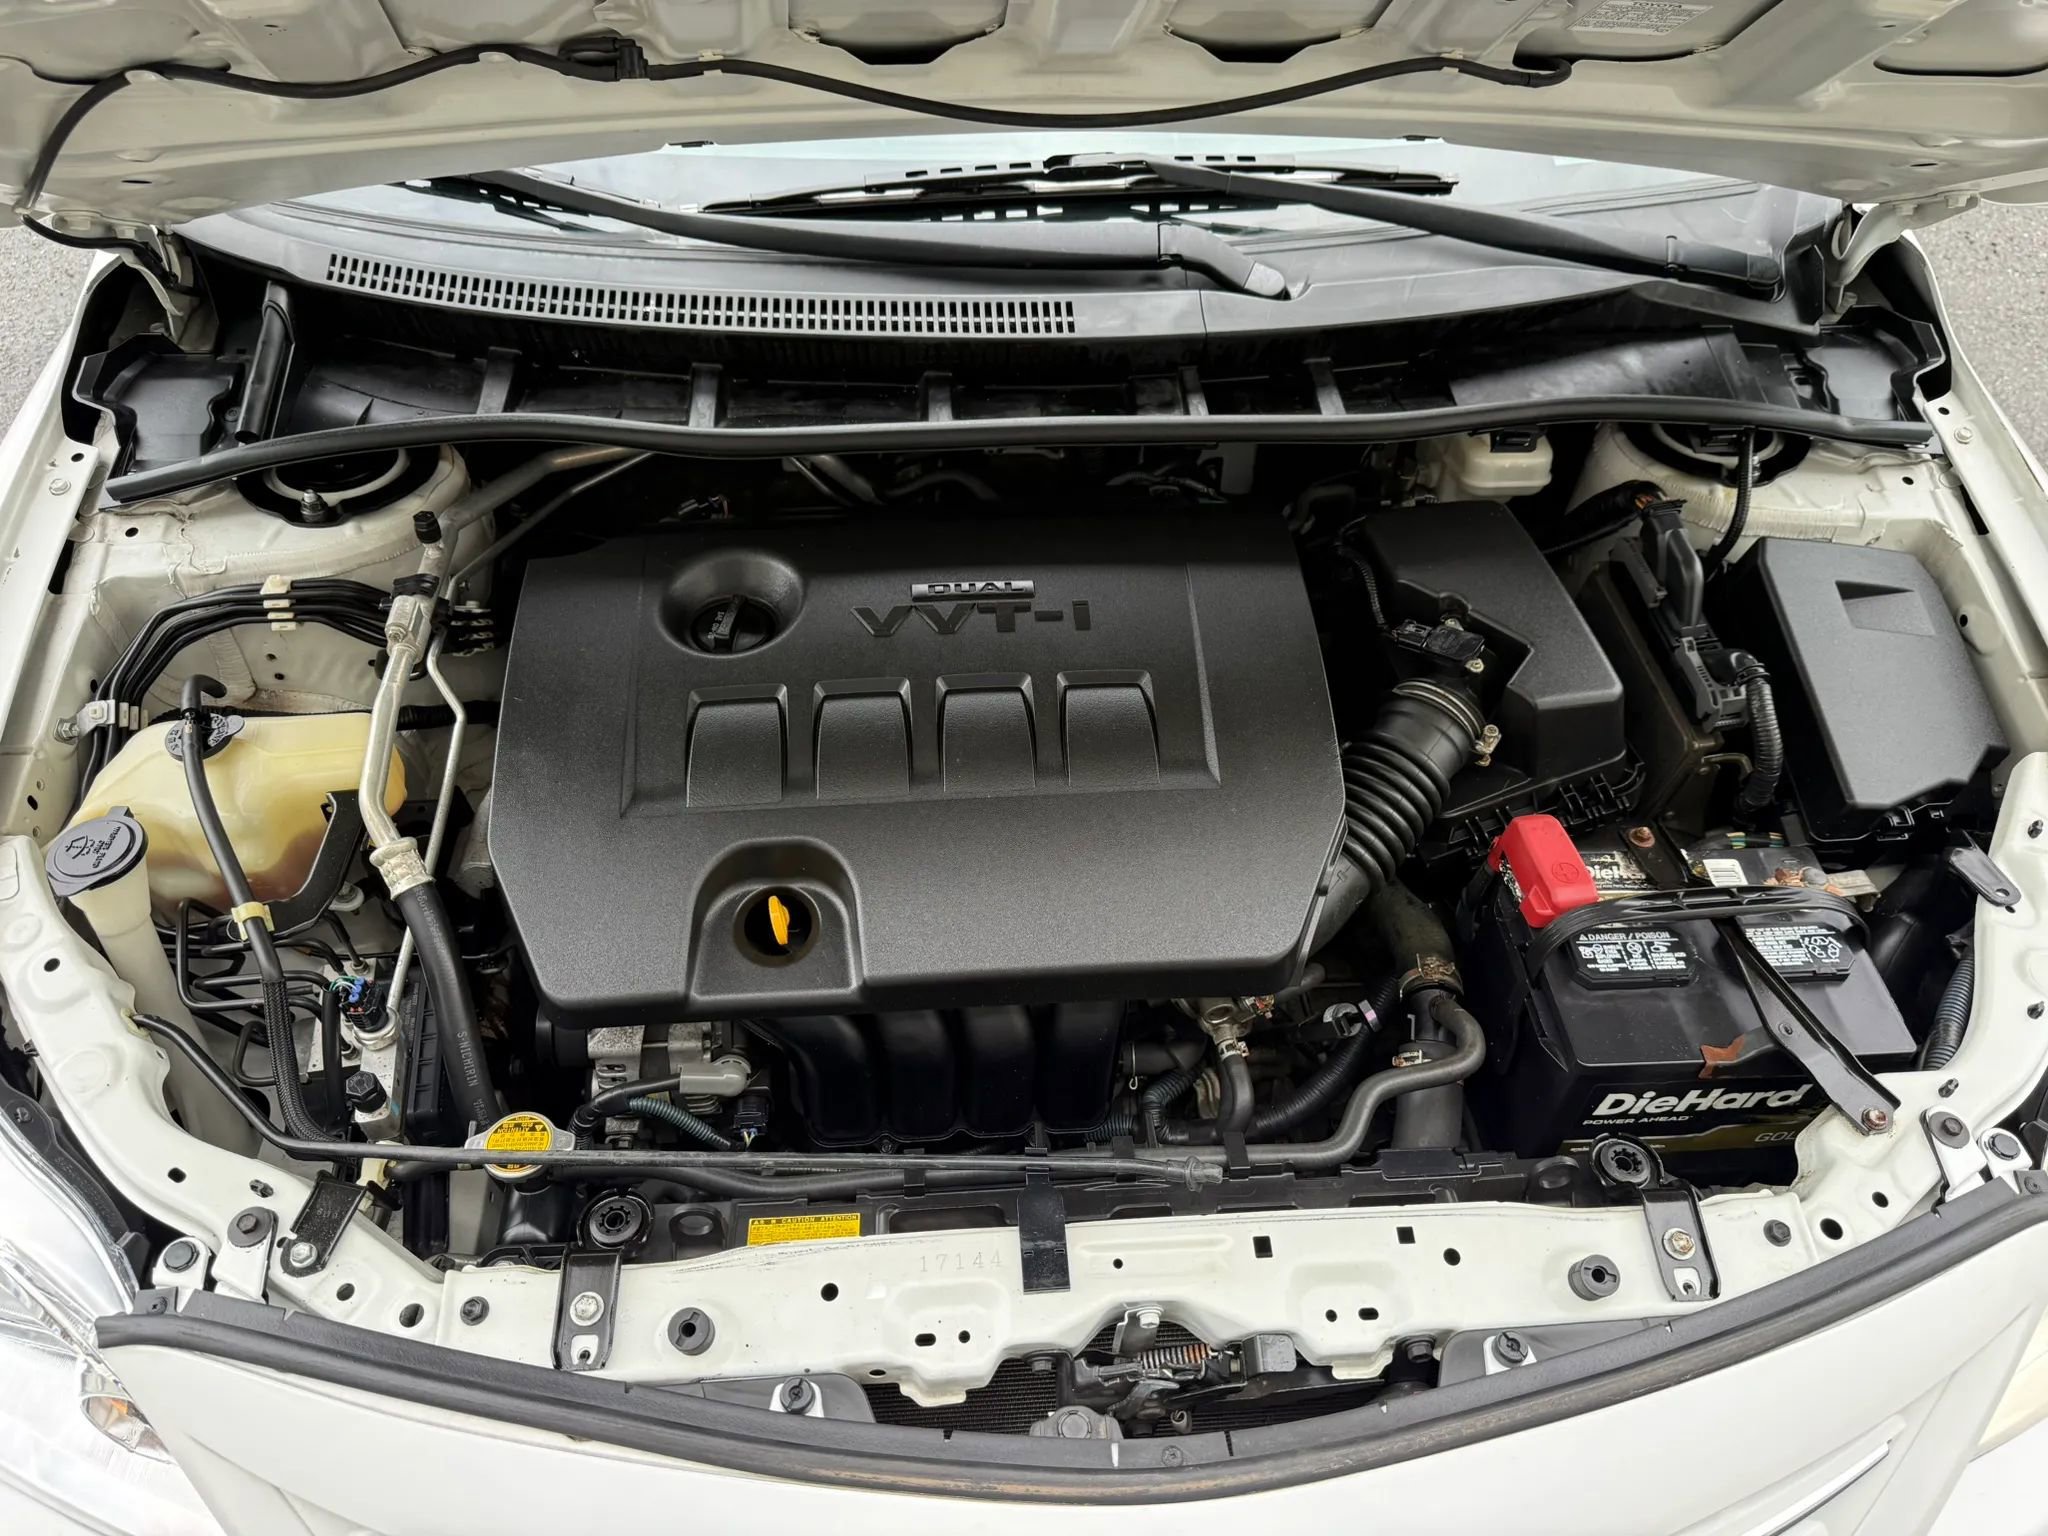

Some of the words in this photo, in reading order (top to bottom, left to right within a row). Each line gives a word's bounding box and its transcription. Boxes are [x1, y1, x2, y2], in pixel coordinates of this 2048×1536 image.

[927, 582, 1024, 593] DUAL
[1592, 1084, 1814, 1116] DieHard
[1754, 1131, 1797, 1142] GOL
[919, 1249, 1002, 1272] 17144
